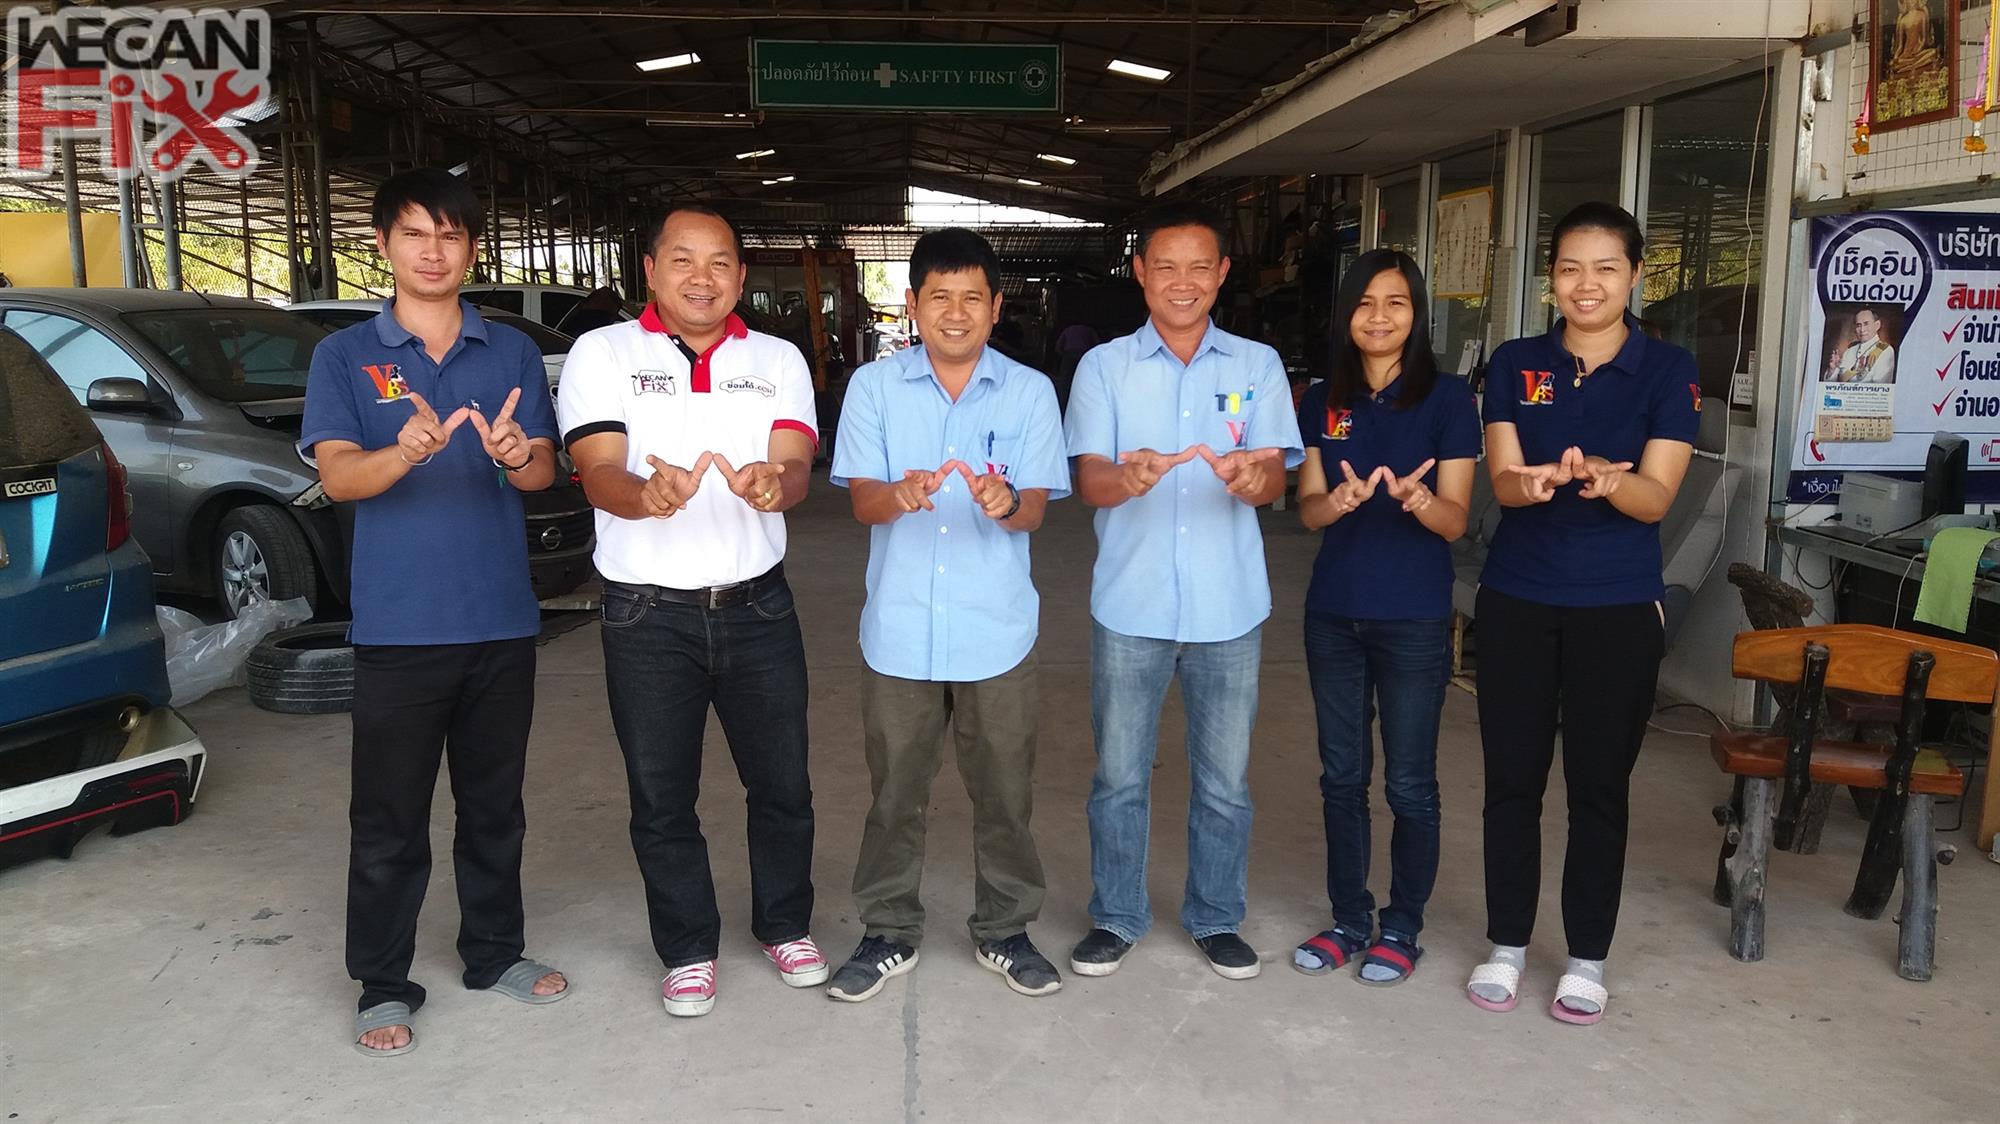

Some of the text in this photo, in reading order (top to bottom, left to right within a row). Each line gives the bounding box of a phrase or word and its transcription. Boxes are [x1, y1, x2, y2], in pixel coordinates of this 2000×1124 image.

[761, 61, 870, 82] ปลอดภัยไว้ก่อน
[969, 70, 1017, 85] FIRST
[1834, 247, 1917, 276] เช็คอิน
[1831, 278, 1915, 301] เงินด่วน
[1947, 283, 2000, 310] สินเ
[9, 480, 52, 494] COCKPIT
